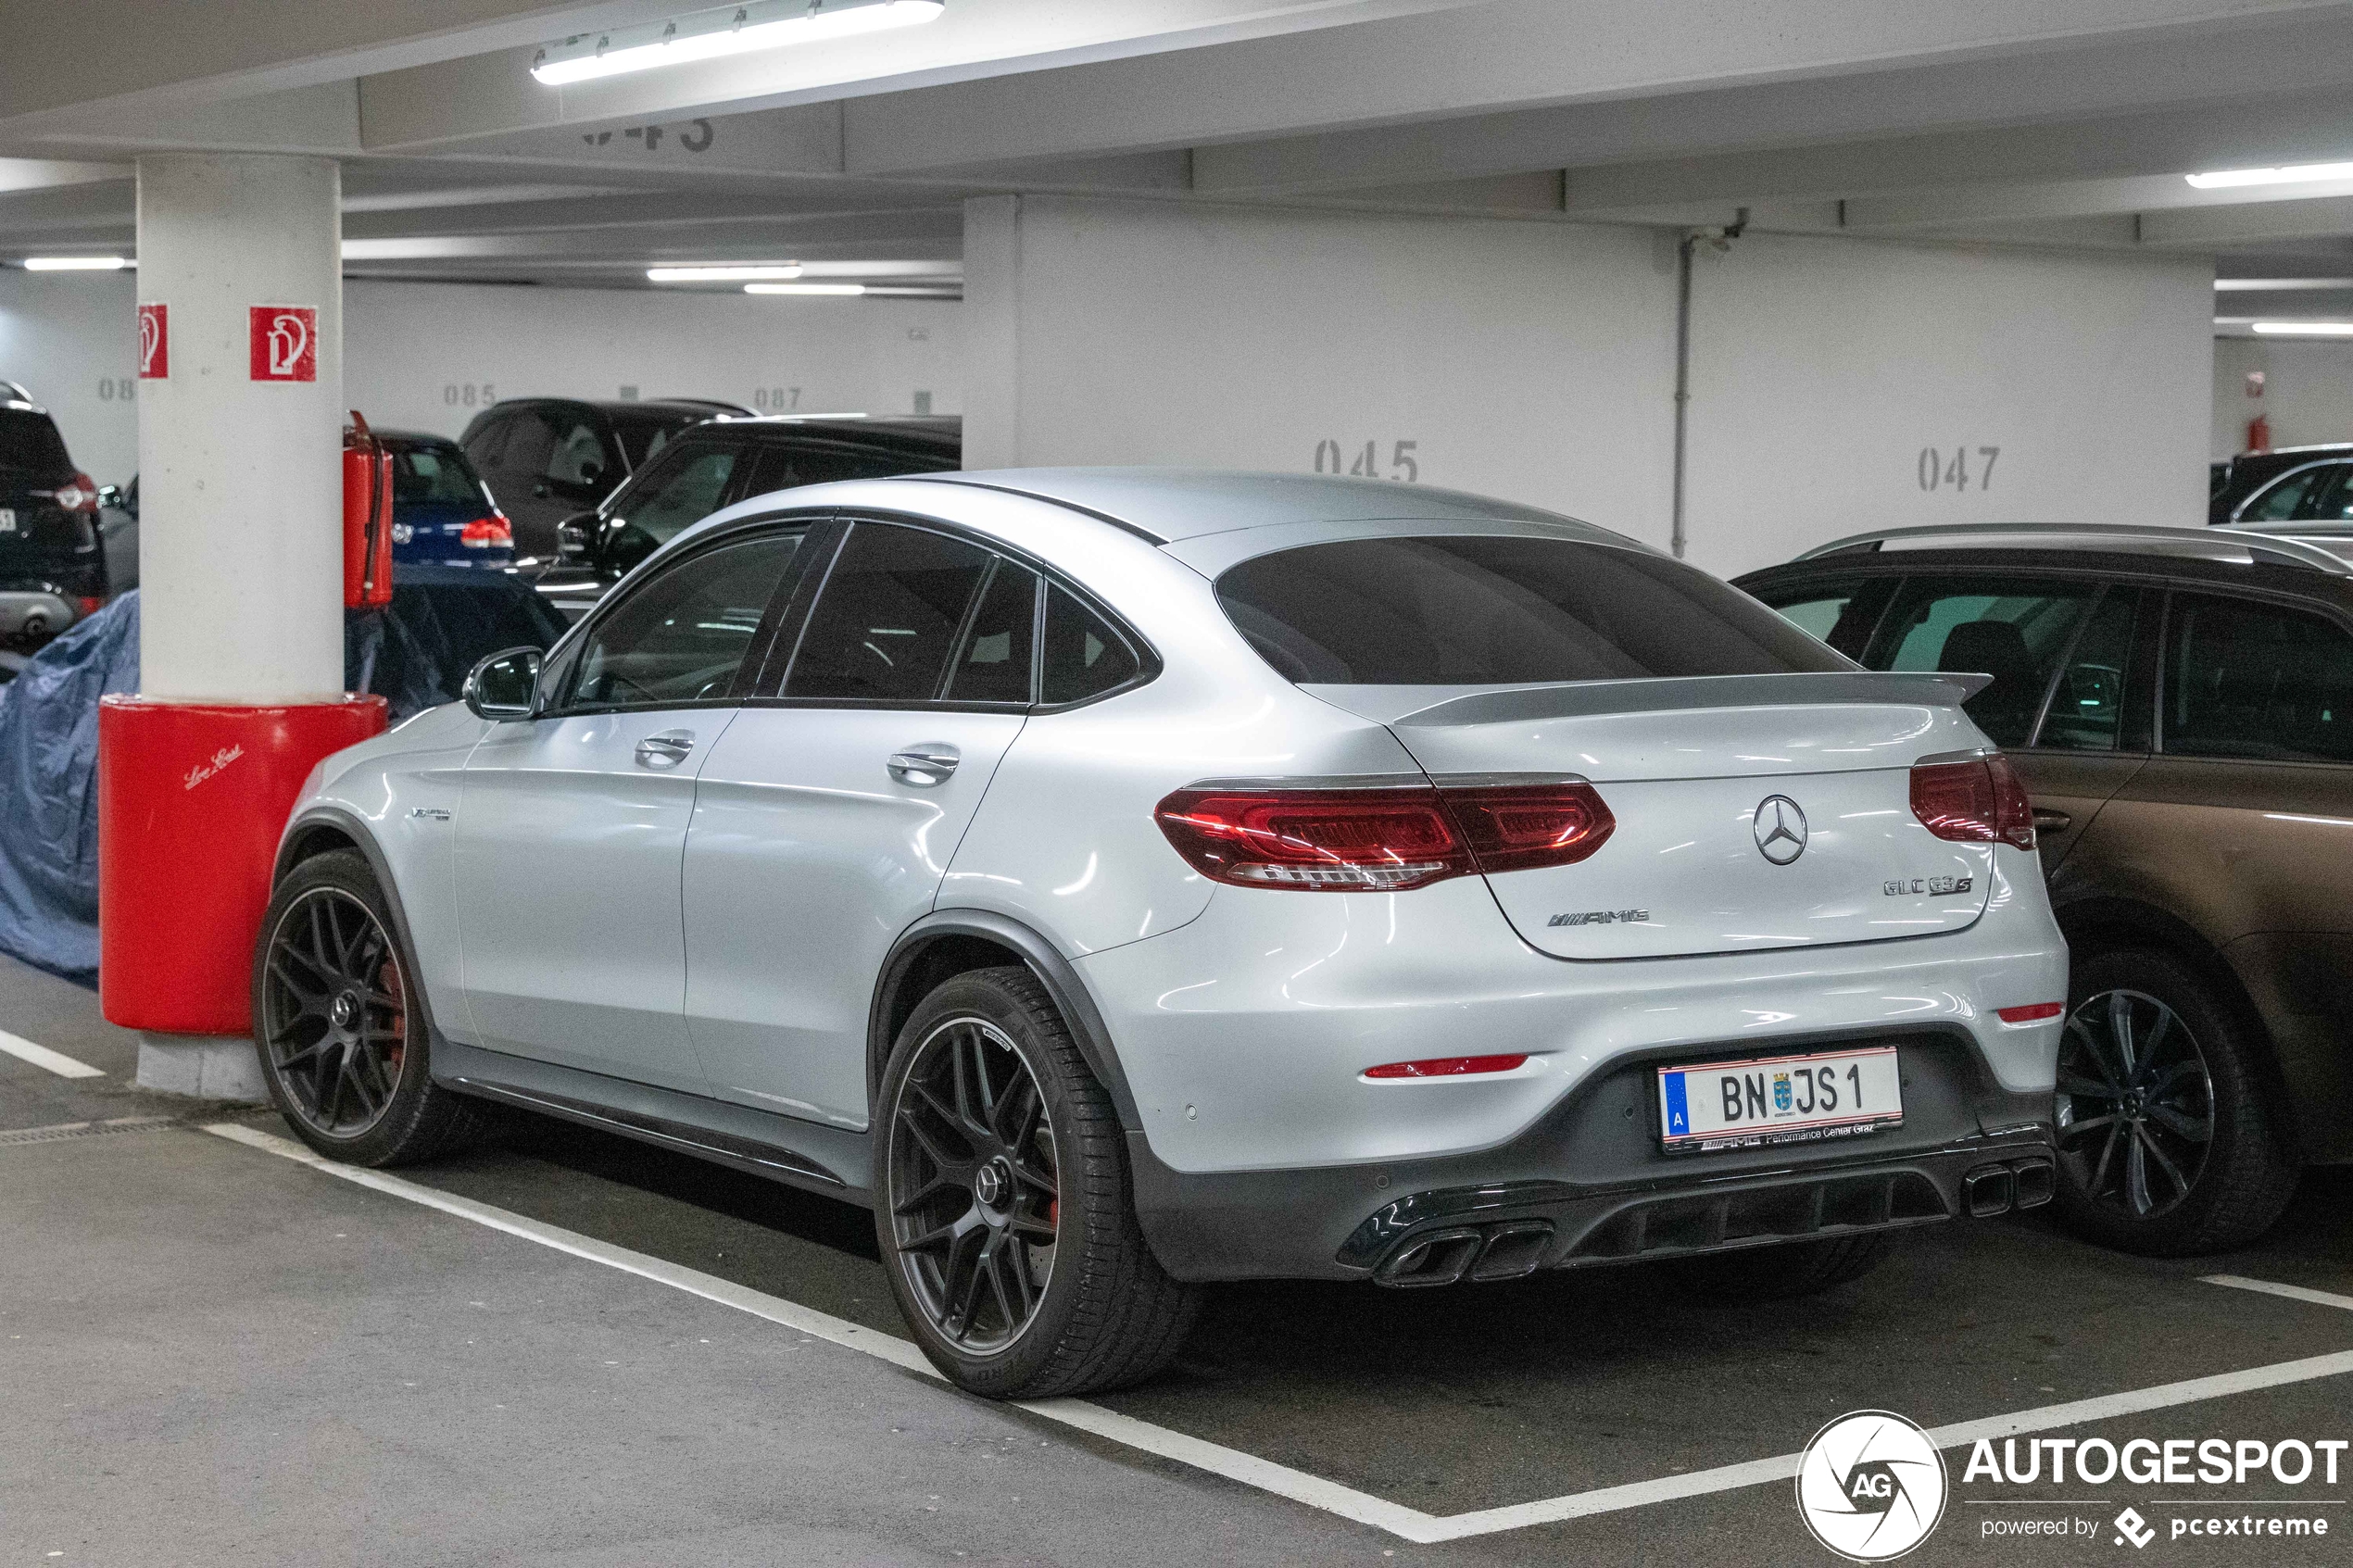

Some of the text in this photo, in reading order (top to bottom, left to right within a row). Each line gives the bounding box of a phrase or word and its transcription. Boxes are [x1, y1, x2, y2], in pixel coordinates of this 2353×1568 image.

[754, 386, 801, 408] 087
[1315, 439, 1417, 482] 045
[1919, 446, 2000, 492] 047
[1884, 879, 1924, 896] GLC
[1581, 909, 1649, 924] AMG
[1721, 1064, 1861, 1122] BN JS 1
[1674, 1112, 1683, 1126] A
[1720, 1135, 1761, 1150] AMG
[1766, 1129, 1821, 1144] Performance
